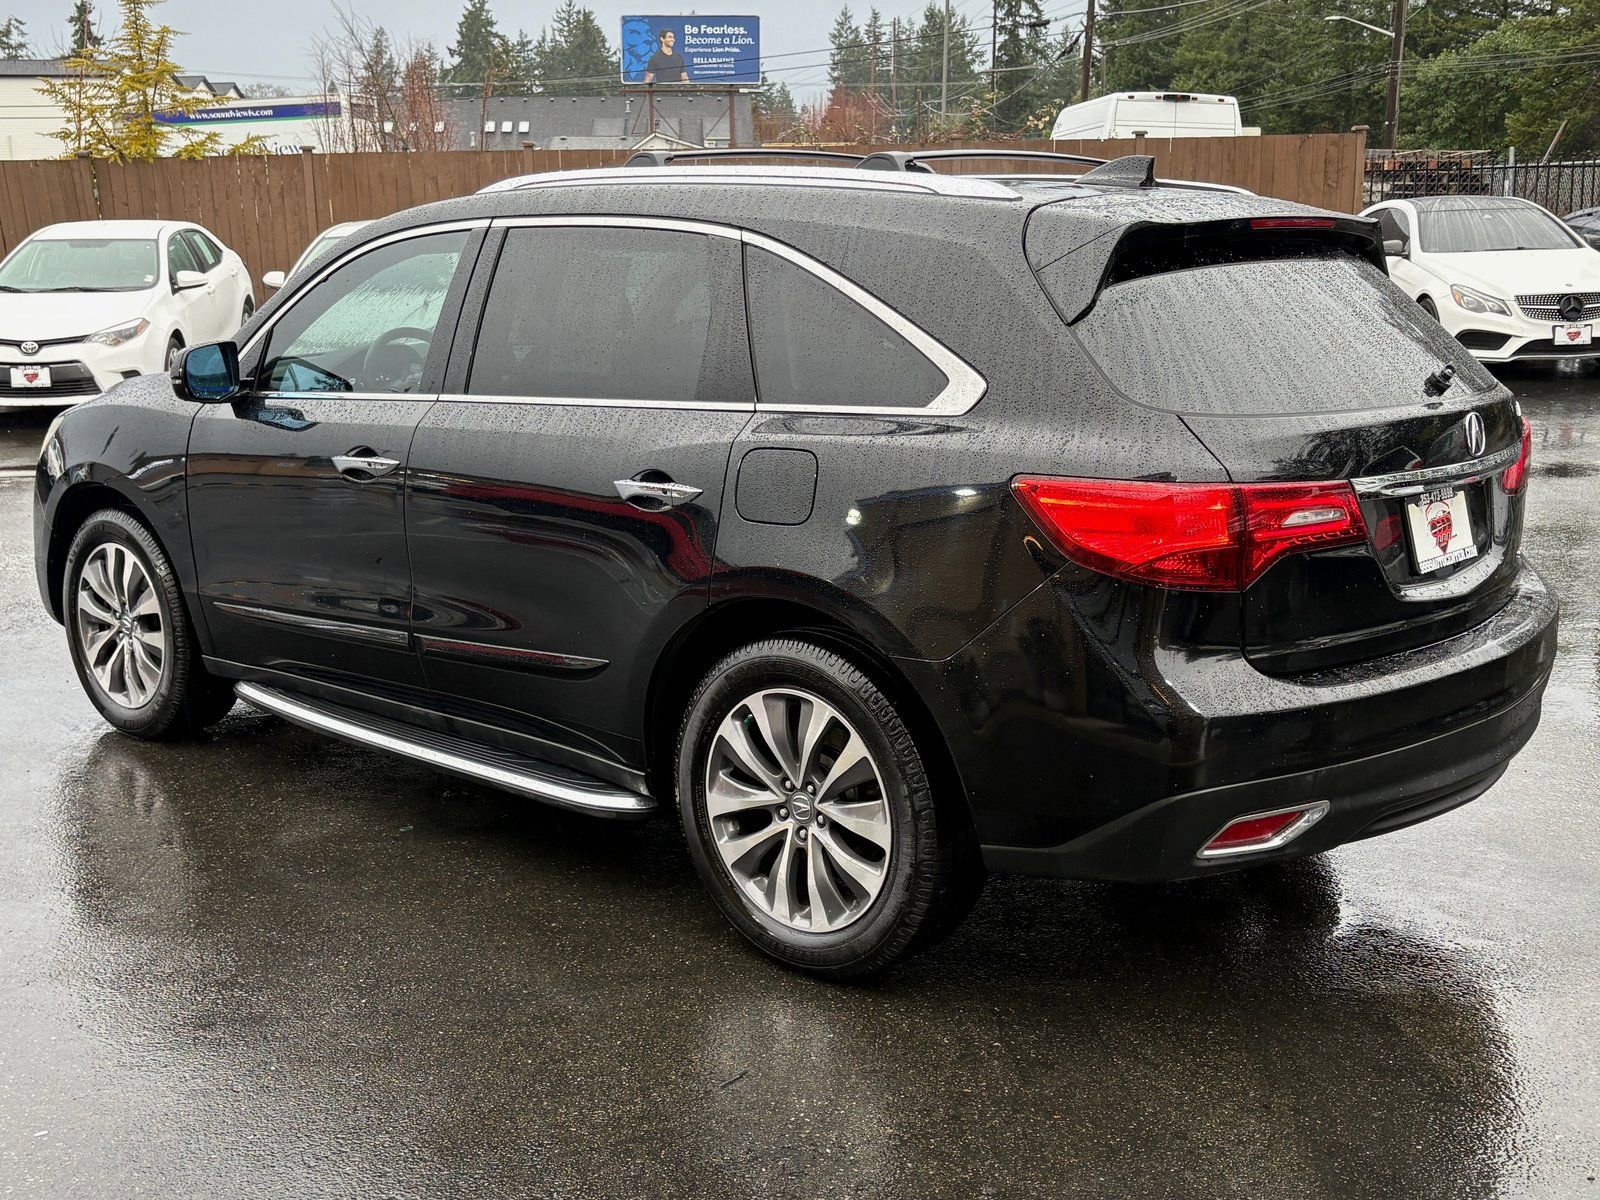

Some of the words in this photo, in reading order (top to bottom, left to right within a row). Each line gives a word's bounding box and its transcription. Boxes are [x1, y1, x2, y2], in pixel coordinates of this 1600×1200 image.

[684, 25, 698, 34] Be
[701, 24, 747, 34] Fearless.
[685, 35, 722, 45] Become
[723, 37, 730, 45] a
[732, 35, 755, 45] Lion.
